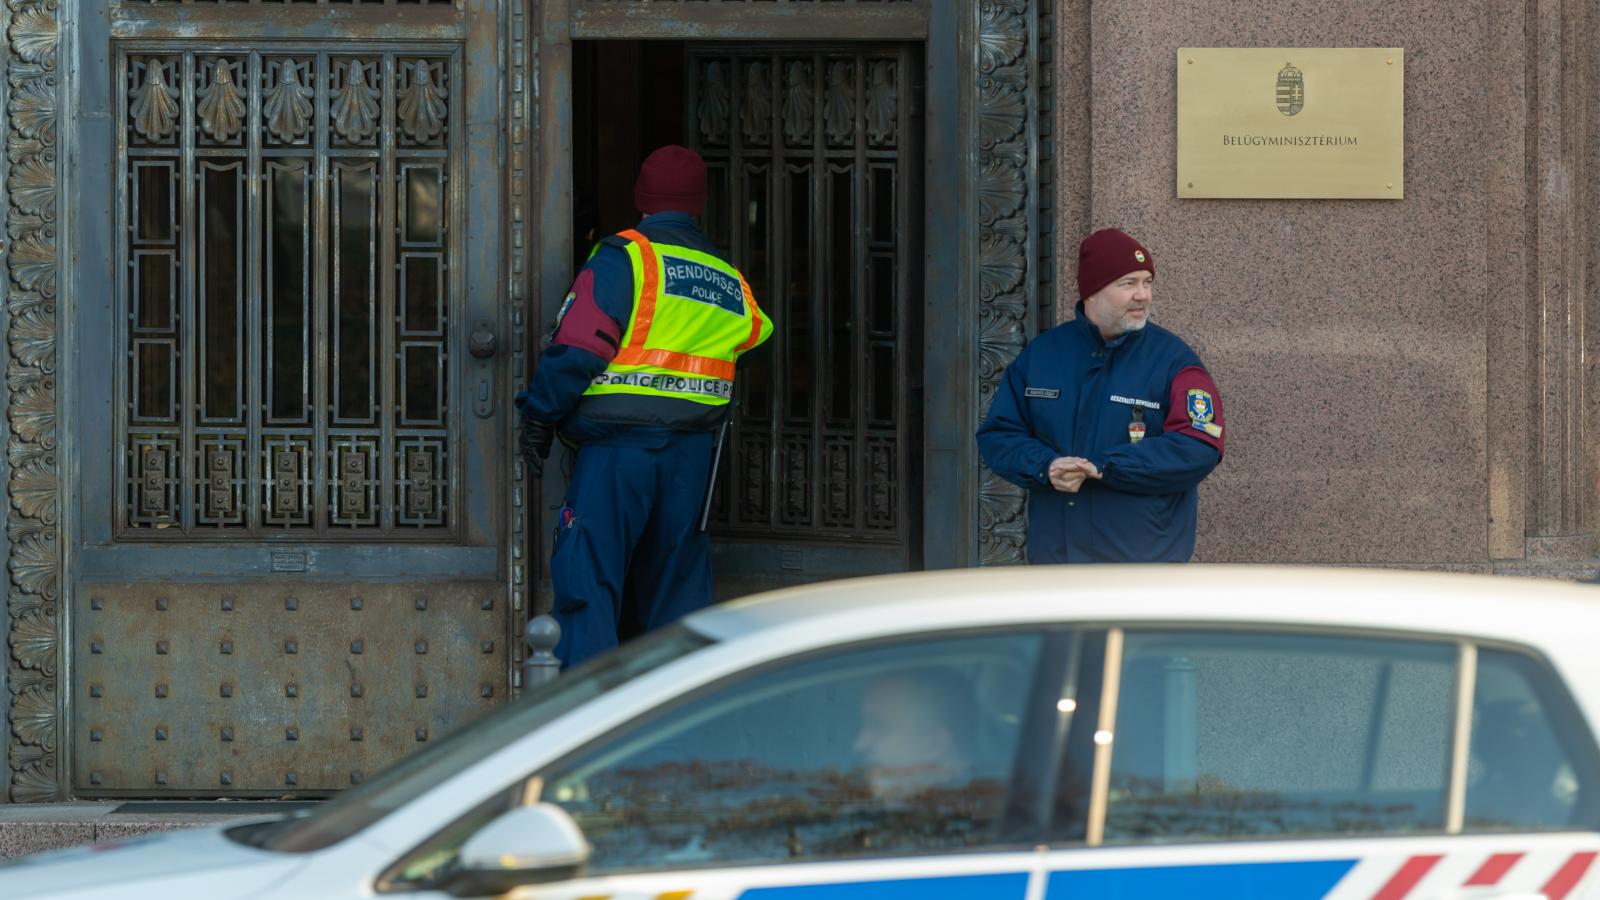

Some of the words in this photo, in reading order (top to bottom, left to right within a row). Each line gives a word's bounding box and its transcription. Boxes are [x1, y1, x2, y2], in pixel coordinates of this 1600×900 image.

[1223, 134, 1358, 146] BELÜGYMINISZTÉRIUM
[692, 285, 723, 303] POLICE
[665, 377, 720, 394] POLICE
